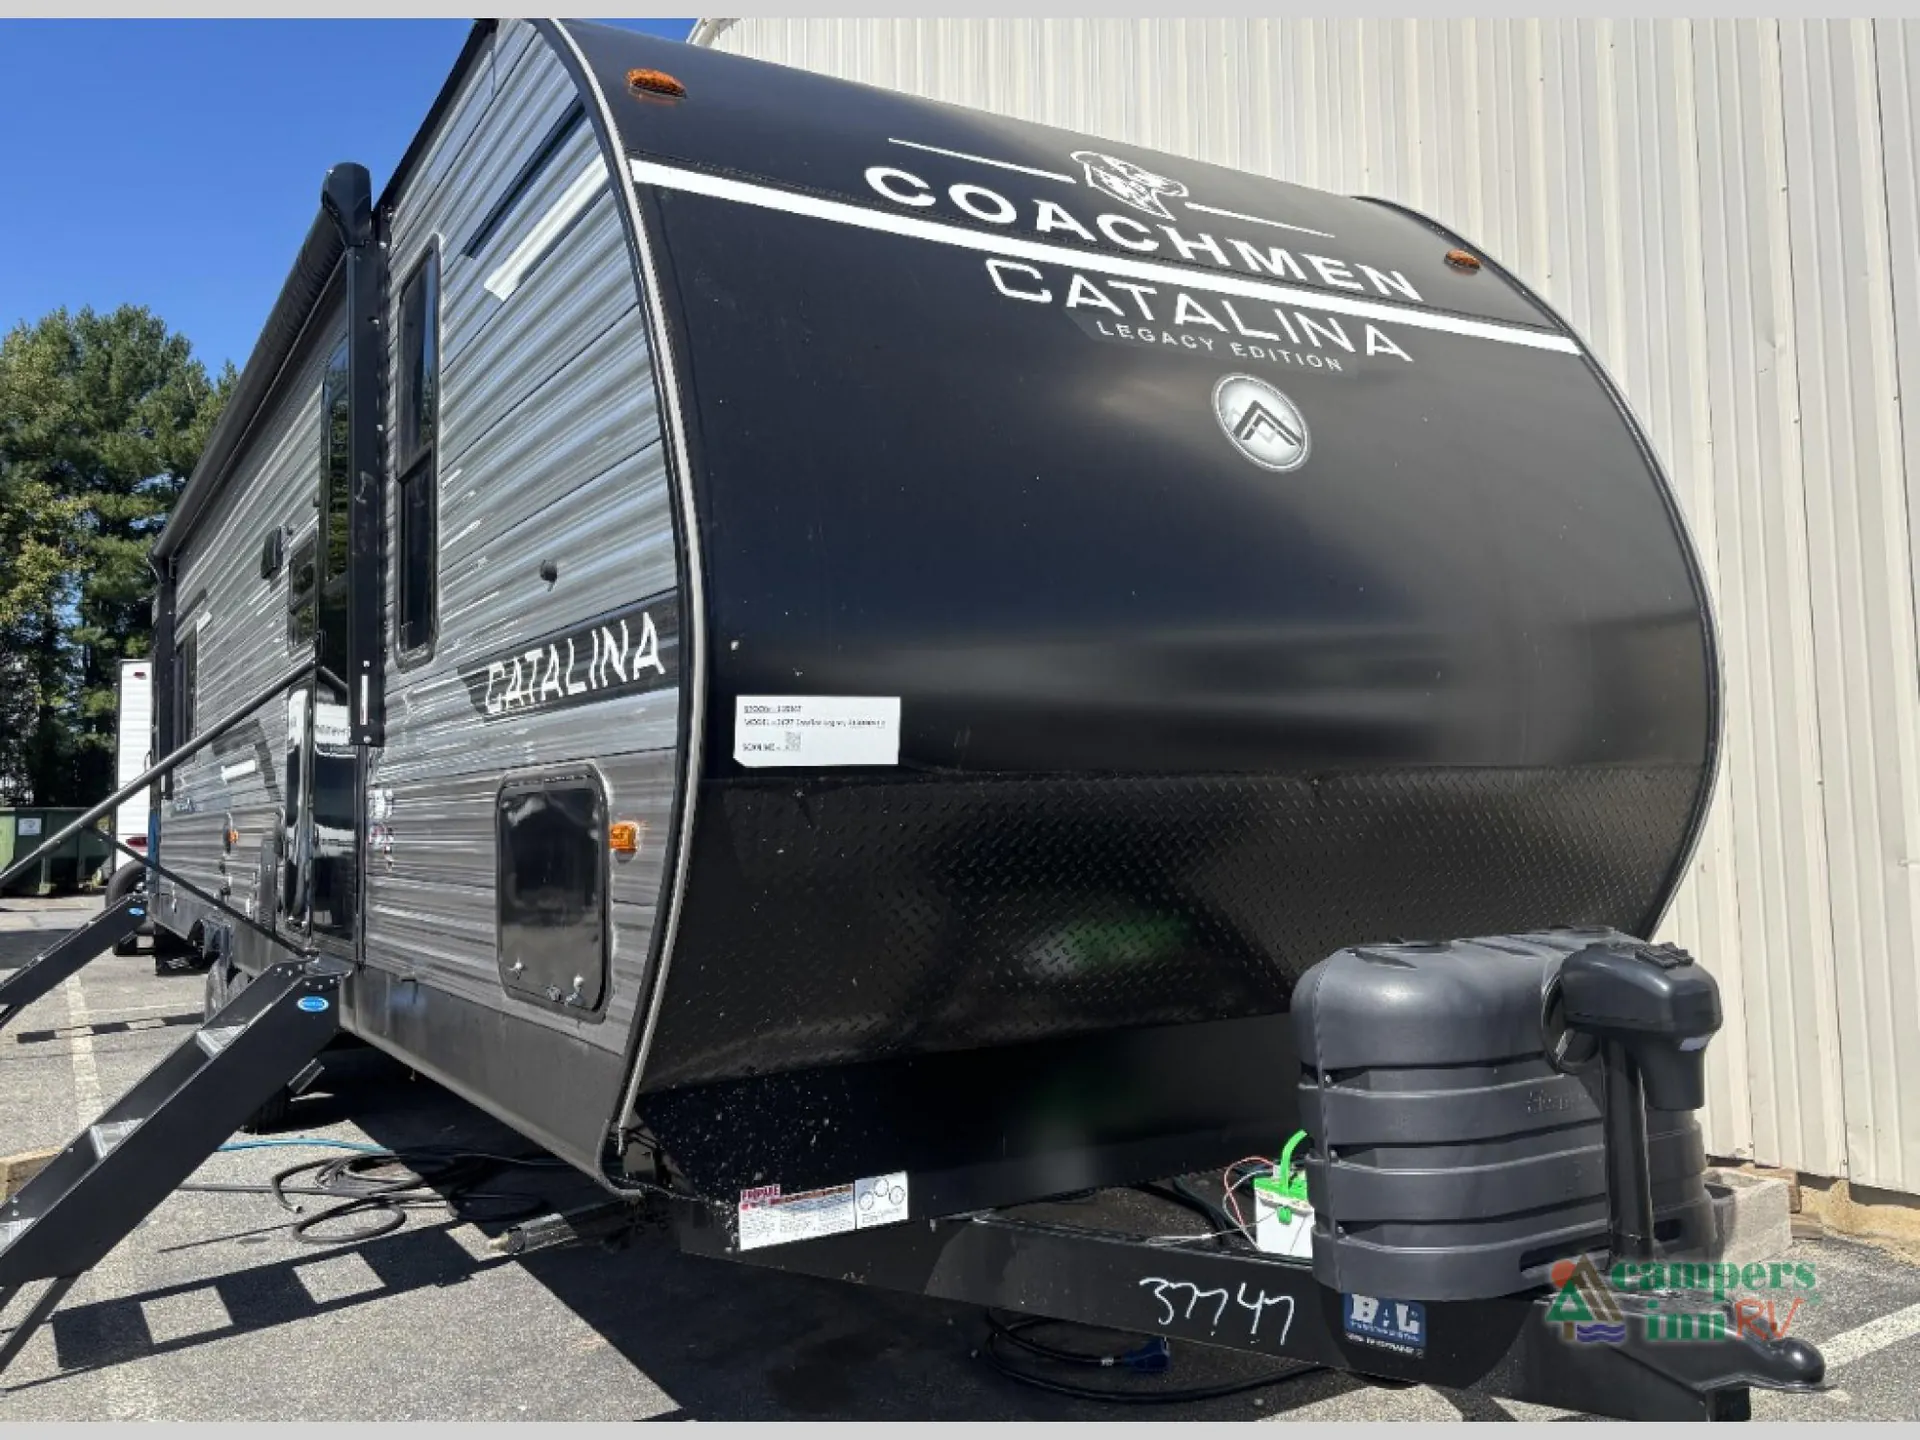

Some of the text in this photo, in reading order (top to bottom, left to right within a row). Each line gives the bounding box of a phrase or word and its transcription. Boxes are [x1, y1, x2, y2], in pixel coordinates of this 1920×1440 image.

[864, 165, 1423, 302] COACHMEN
[985, 257, 1413, 362] CATALINA
[1096, 320, 1343, 372] LEGACY EDITION
[485, 611, 666, 713] CATALINA
